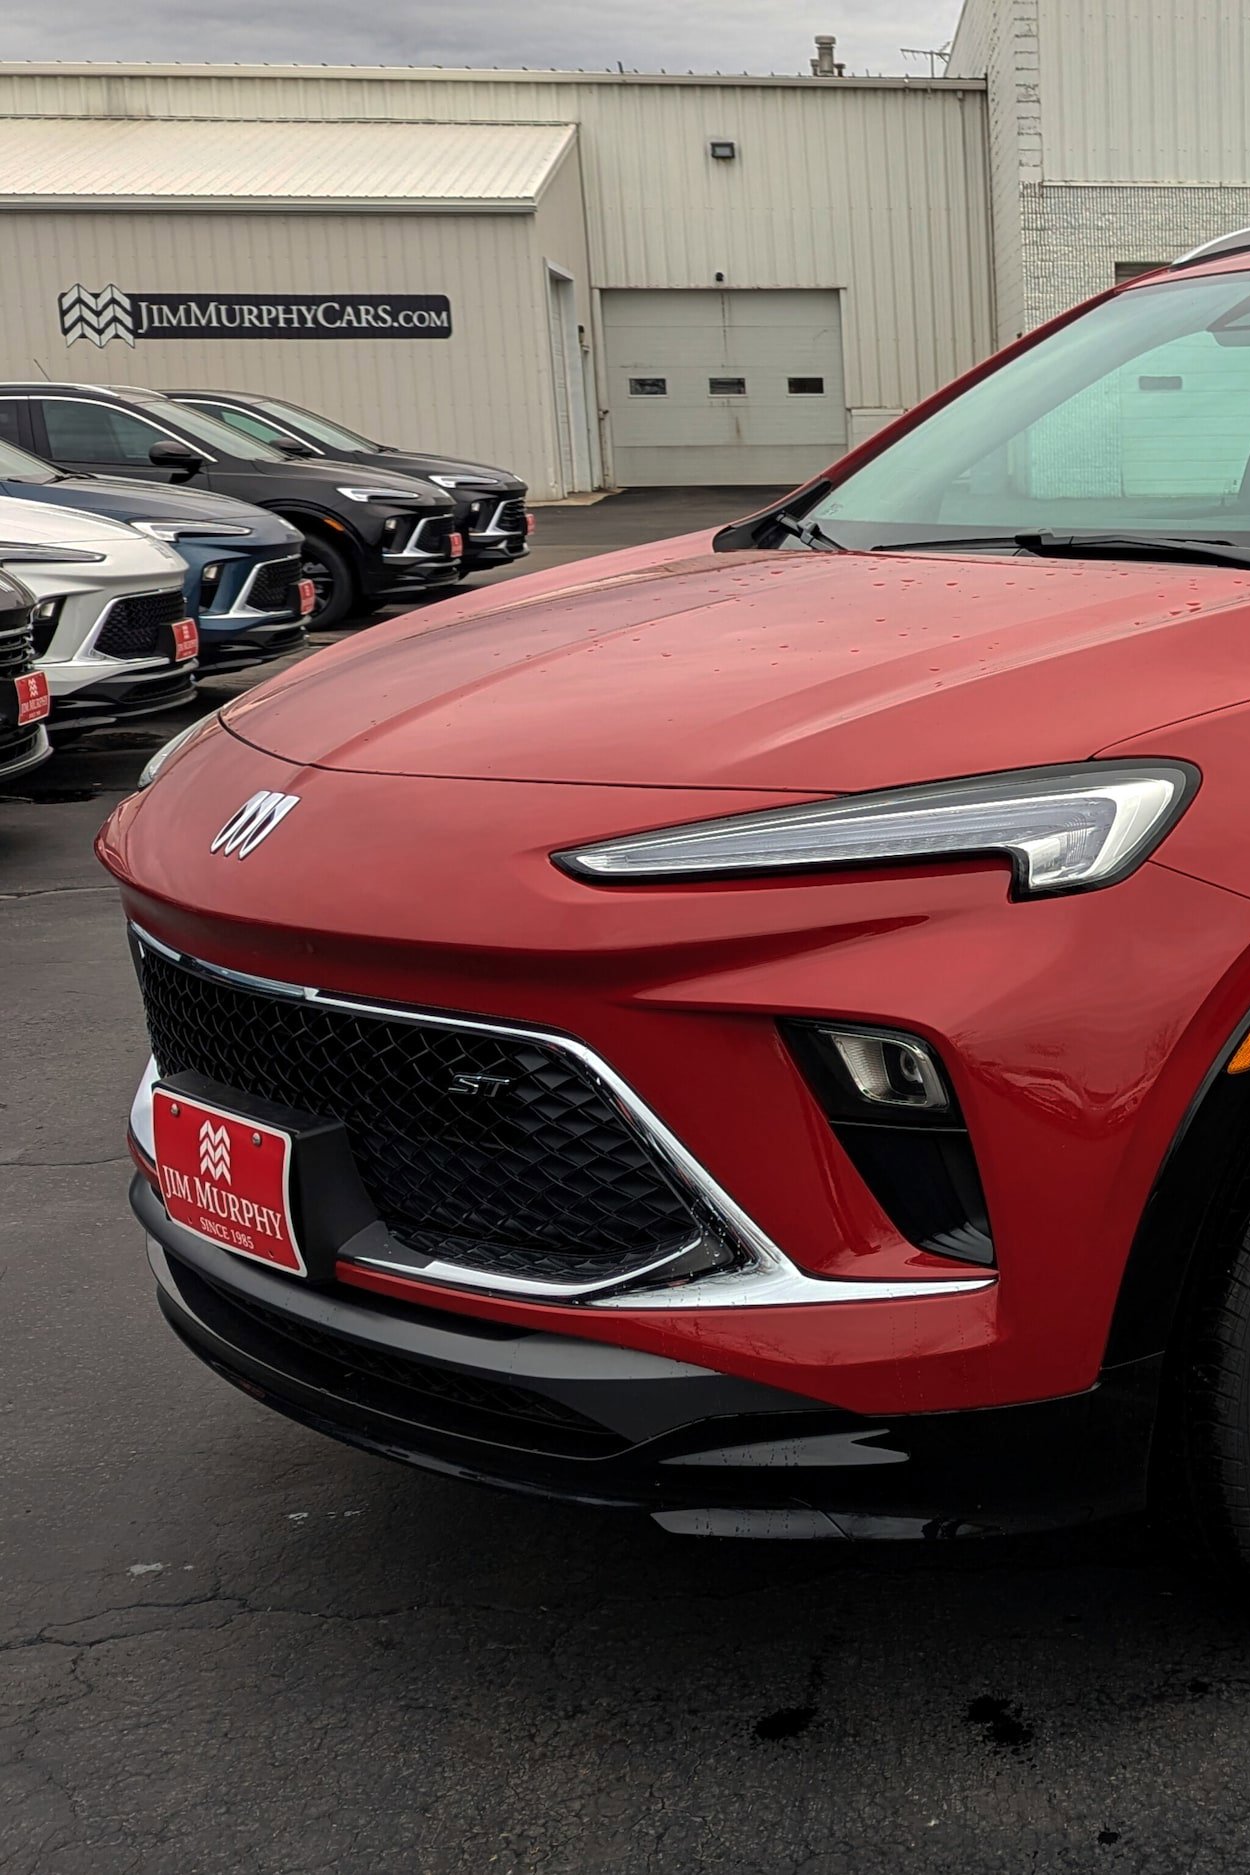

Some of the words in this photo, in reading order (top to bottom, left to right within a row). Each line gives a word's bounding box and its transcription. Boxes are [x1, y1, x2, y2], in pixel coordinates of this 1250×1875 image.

[162, 1164, 194, 1204] JIM
[193, 1176, 284, 1241] MURPHY
[199, 1216, 231, 1241] SINCE
[230, 1229, 255, 1250] 1985
